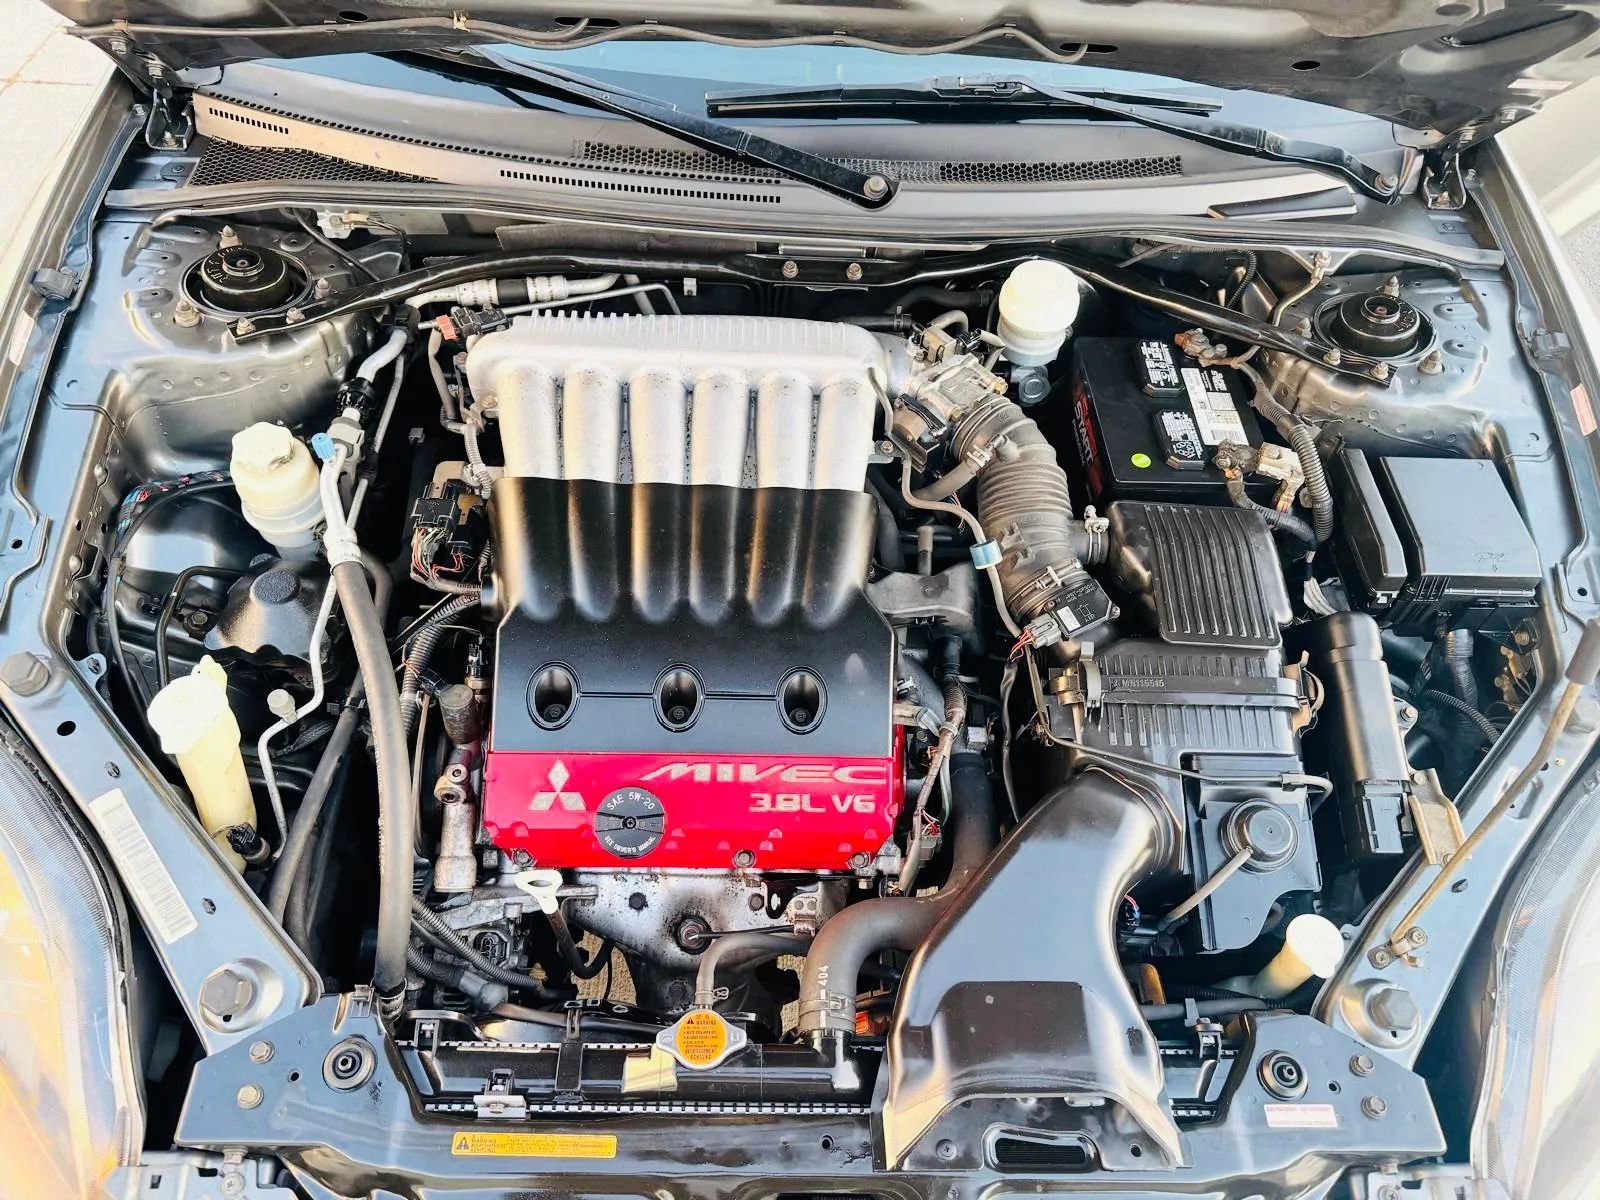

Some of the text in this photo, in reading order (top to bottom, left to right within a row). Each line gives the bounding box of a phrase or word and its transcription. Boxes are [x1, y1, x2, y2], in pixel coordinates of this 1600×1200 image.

[1074, 400, 1094, 466] START
[640, 763, 886, 784] MIVEC
[607, 791, 655, 810] SAE 5W-20
[750, 793, 876, 813] 3.8L V6
[604, 835, 657, 854] SEE OWNER'S MANUAL
[817, 965, 829, 986] 404
